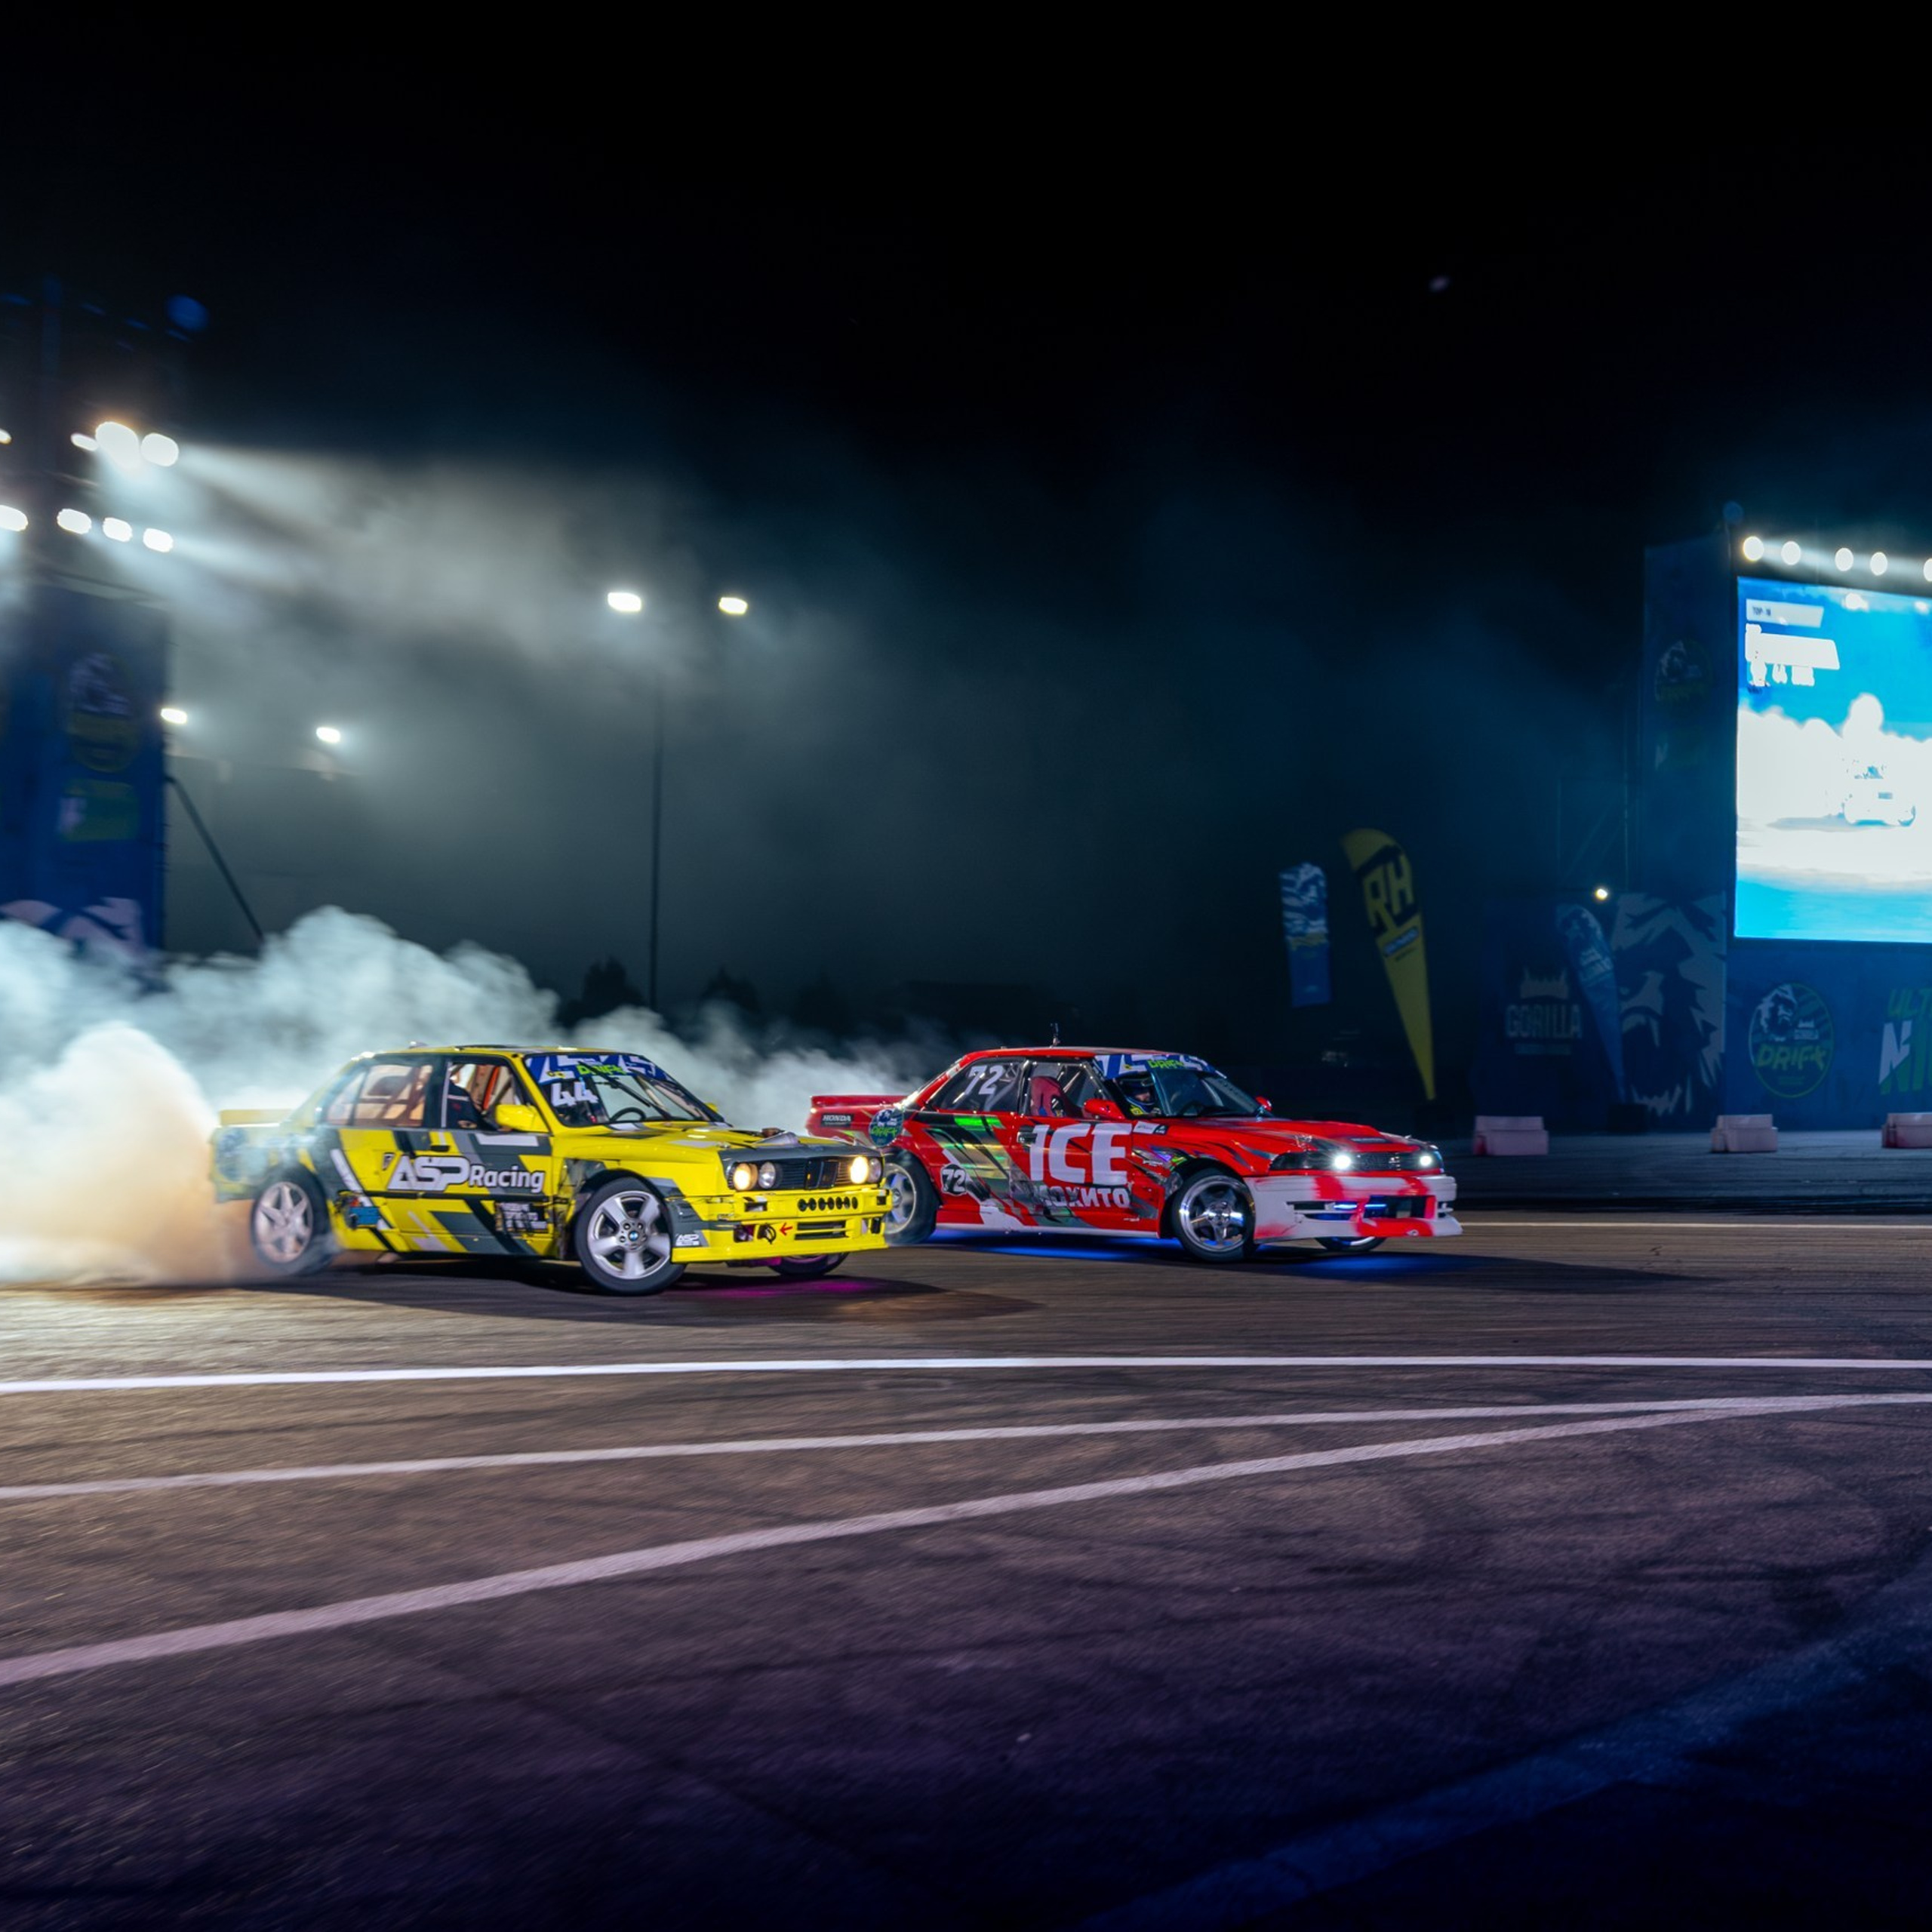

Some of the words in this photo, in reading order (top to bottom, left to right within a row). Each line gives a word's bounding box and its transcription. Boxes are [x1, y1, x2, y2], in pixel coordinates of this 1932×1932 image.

[1362, 852, 1415, 928] RH
[1506, 1003, 1583, 1039] GORILLA
[551, 1081, 598, 1107] 44
[965, 1064, 1004, 1095] 72
[1029, 1122, 1132, 1186] ICE
[386, 1155, 470, 1191] ASP
[469, 1165, 545, 1193] Racing
[942, 1168, 966, 1192] 72
